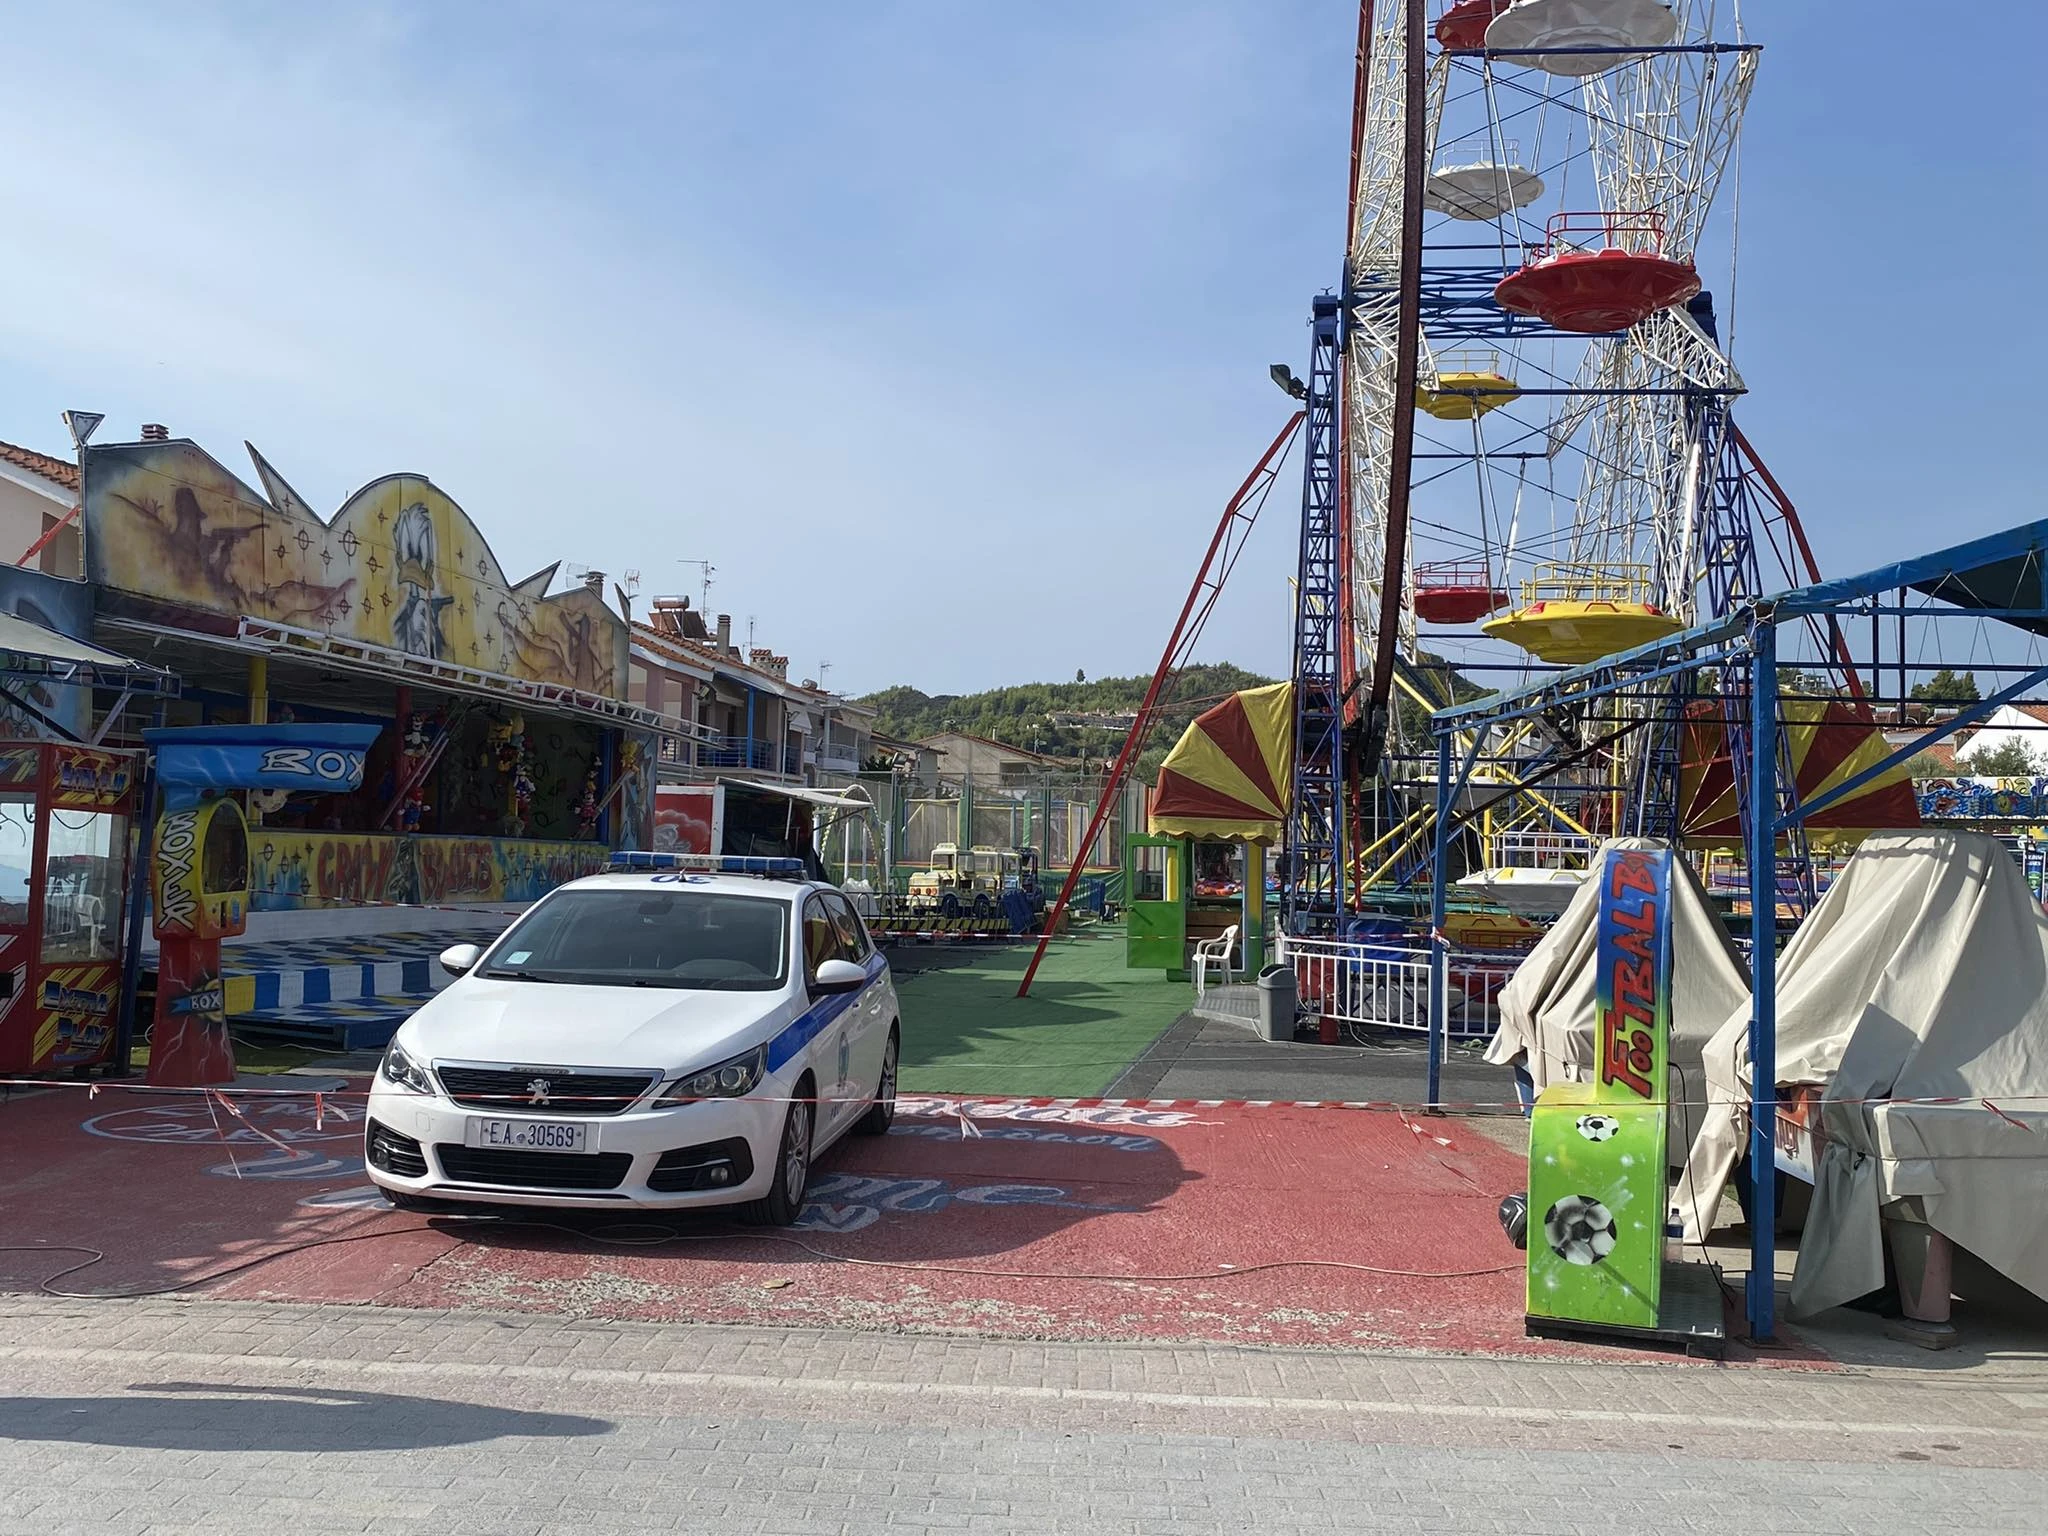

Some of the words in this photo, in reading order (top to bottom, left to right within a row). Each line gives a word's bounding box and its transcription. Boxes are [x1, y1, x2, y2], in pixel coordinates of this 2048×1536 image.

[258, 747, 365, 782] BOX
[156, 809, 199, 932] BOXER
[191, 990, 222, 1010] BOX
[527, 1125, 575, 1148] 30569
